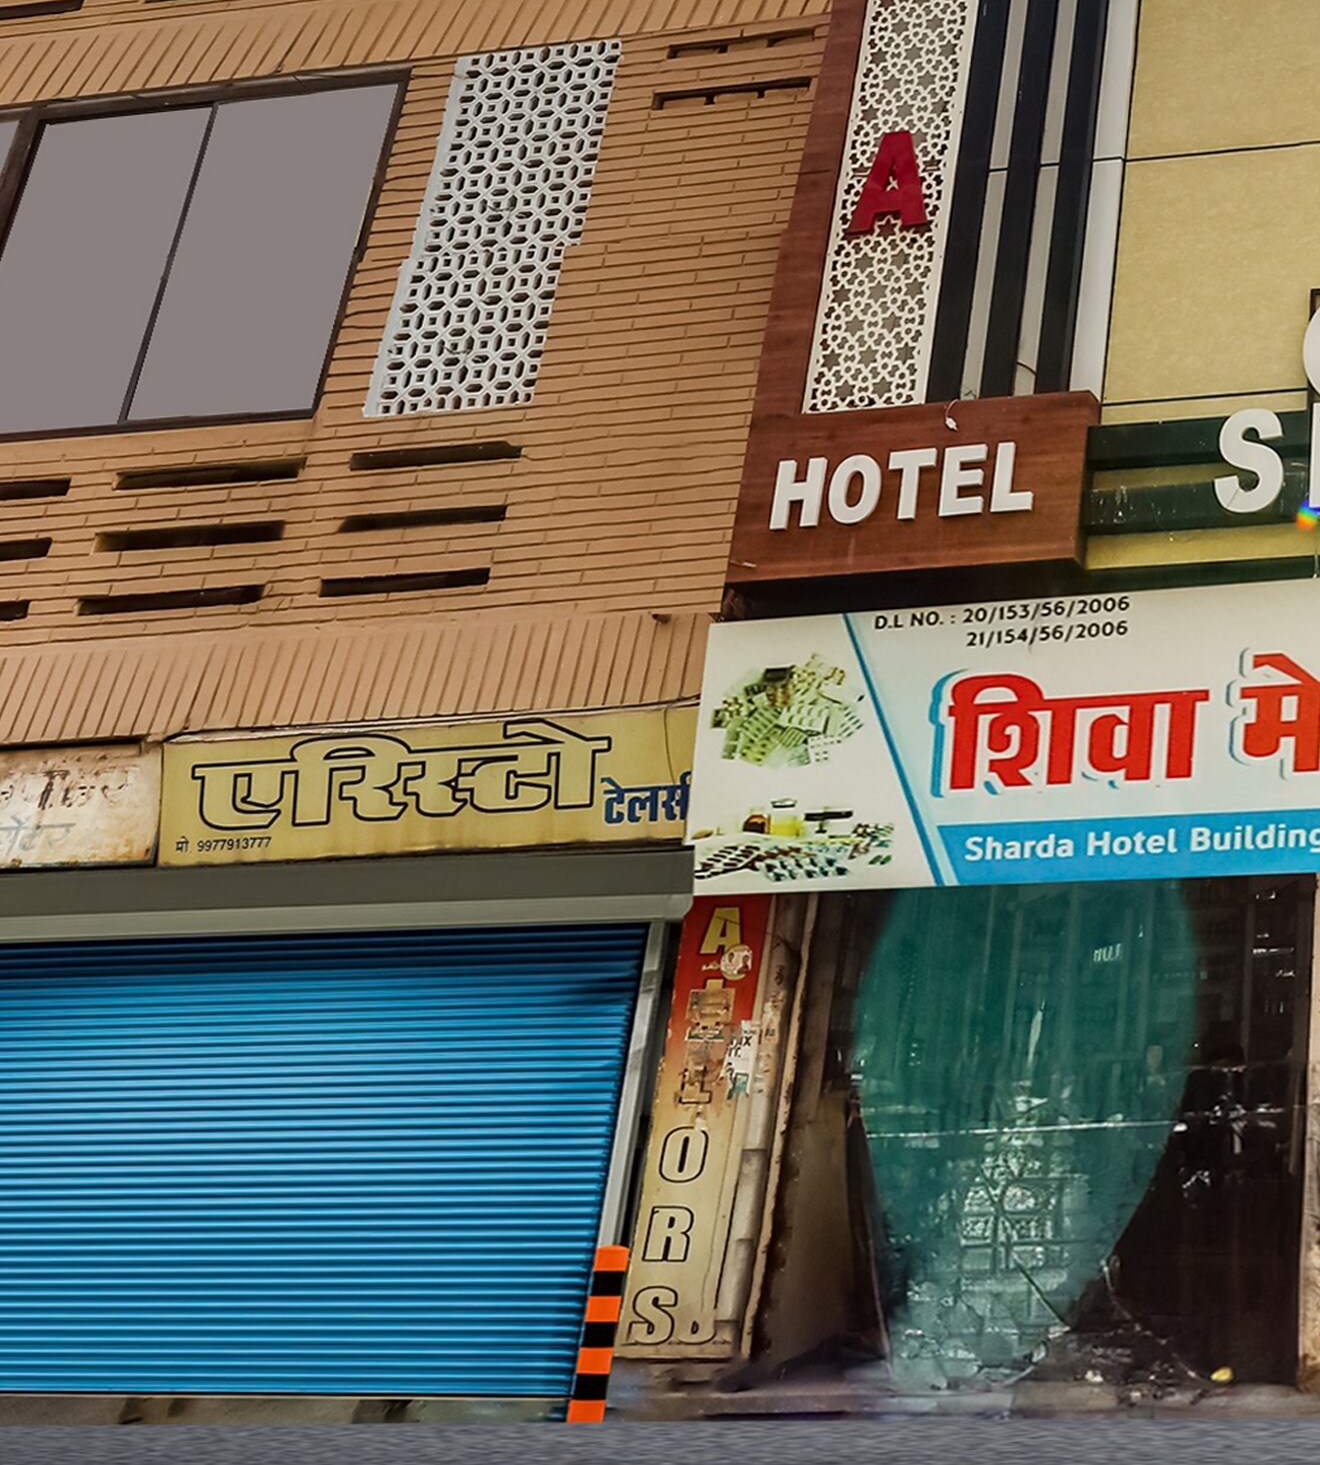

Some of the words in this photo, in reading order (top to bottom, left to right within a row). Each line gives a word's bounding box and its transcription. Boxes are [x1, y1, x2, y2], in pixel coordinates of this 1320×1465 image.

[769, 442, 1033, 530] HOTEL
[875, 615, 903, 630] D.L
[910, 611, 944, 627] NO.
[962, 596, 1130, 625] 20/153/56/2006
[966, 620, 1128, 649] 21/154/56/2006
[945, 671, 1210, 792] शिवा
[191, 719, 611, 831] एरिस्टो
[197, 837, 272, 852] 9977913777
[964, 835, 1073, 862] Sharda
[1086, 830, 1176, 858] Hotel
